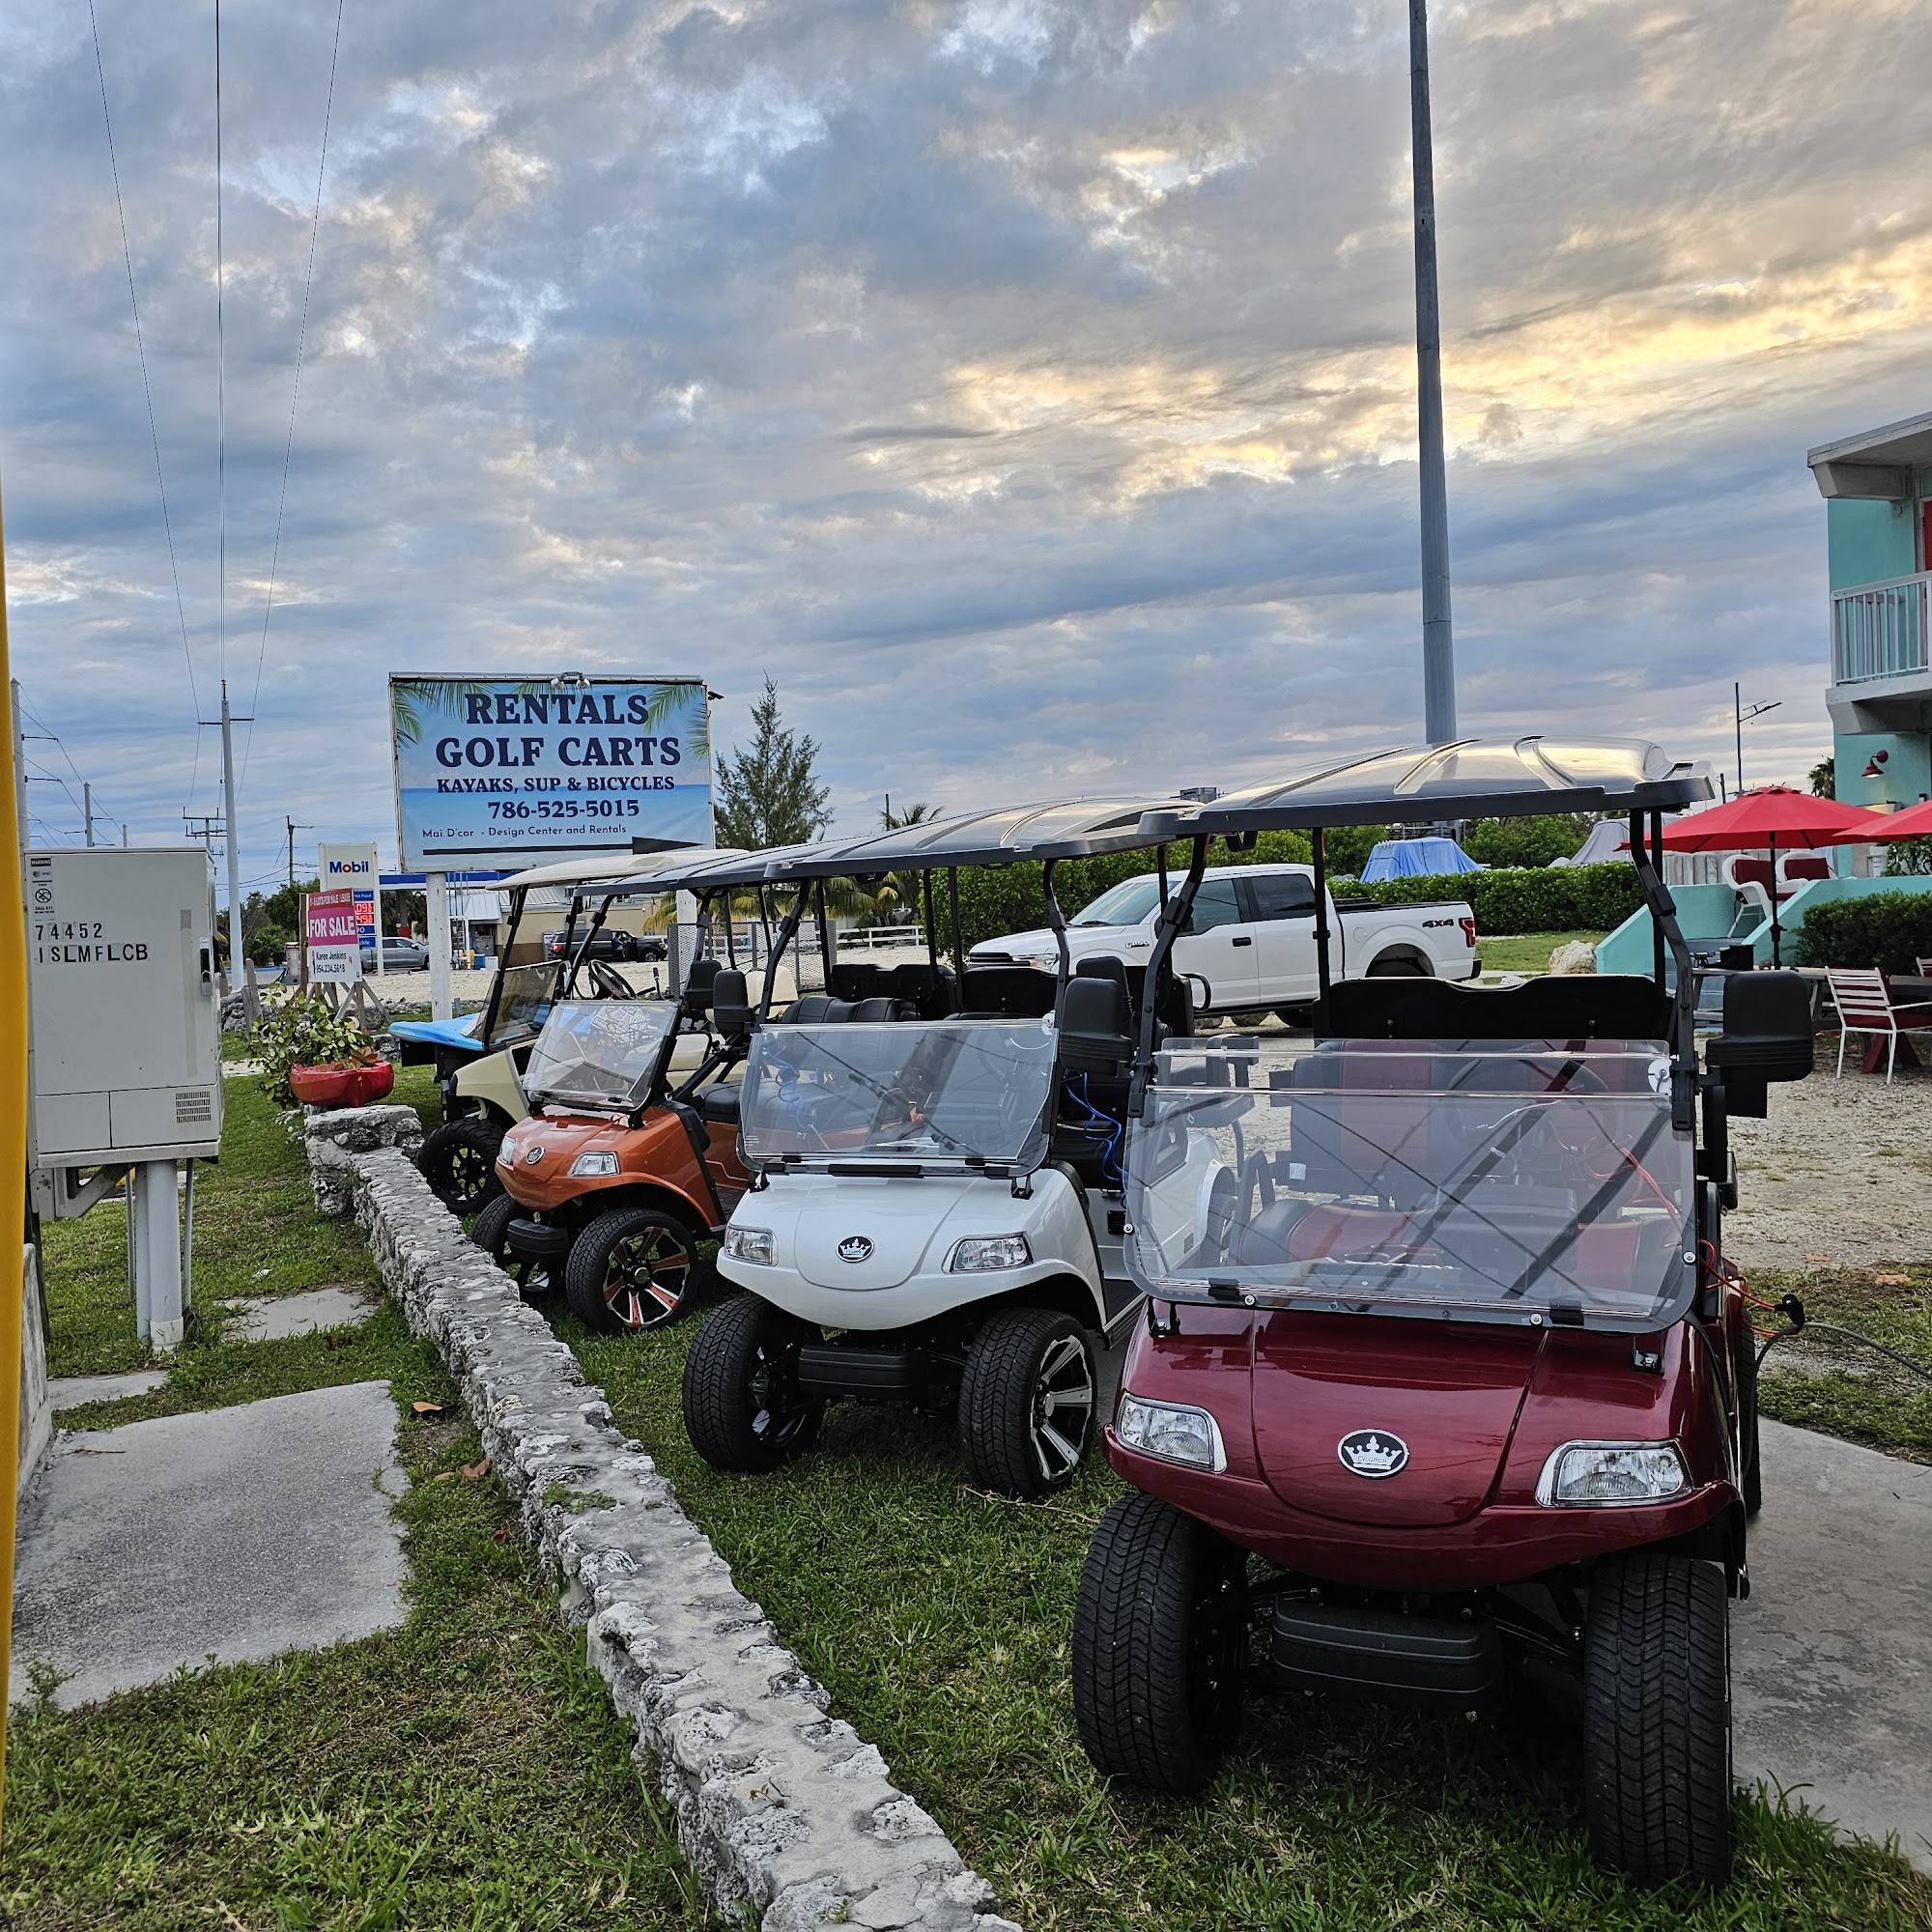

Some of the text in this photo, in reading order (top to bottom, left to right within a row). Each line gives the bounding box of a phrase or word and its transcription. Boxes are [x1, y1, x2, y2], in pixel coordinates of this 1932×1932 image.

[465, 694, 649, 724] RENTALS
[436, 737, 681, 768] GOLF CARTS
[437, 776, 675, 794] KAYAKS, SUP & BICYCLES
[487, 799, 639, 819] 786-525-5015
[422, 828, 443, 838] Mai
[489, 826, 525, 837] Design
[527, 826, 562, 836] Center
[566, 825, 585, 835] and
[589, 824, 627, 834] Rentals
[329, 861, 369, 873] Mobil
[35, 923, 102, 941] 74452
[309, 919, 327, 938] FOR
[328, 915, 355, 937] SALE
[39, 944, 149, 963] ISLMFLCB
